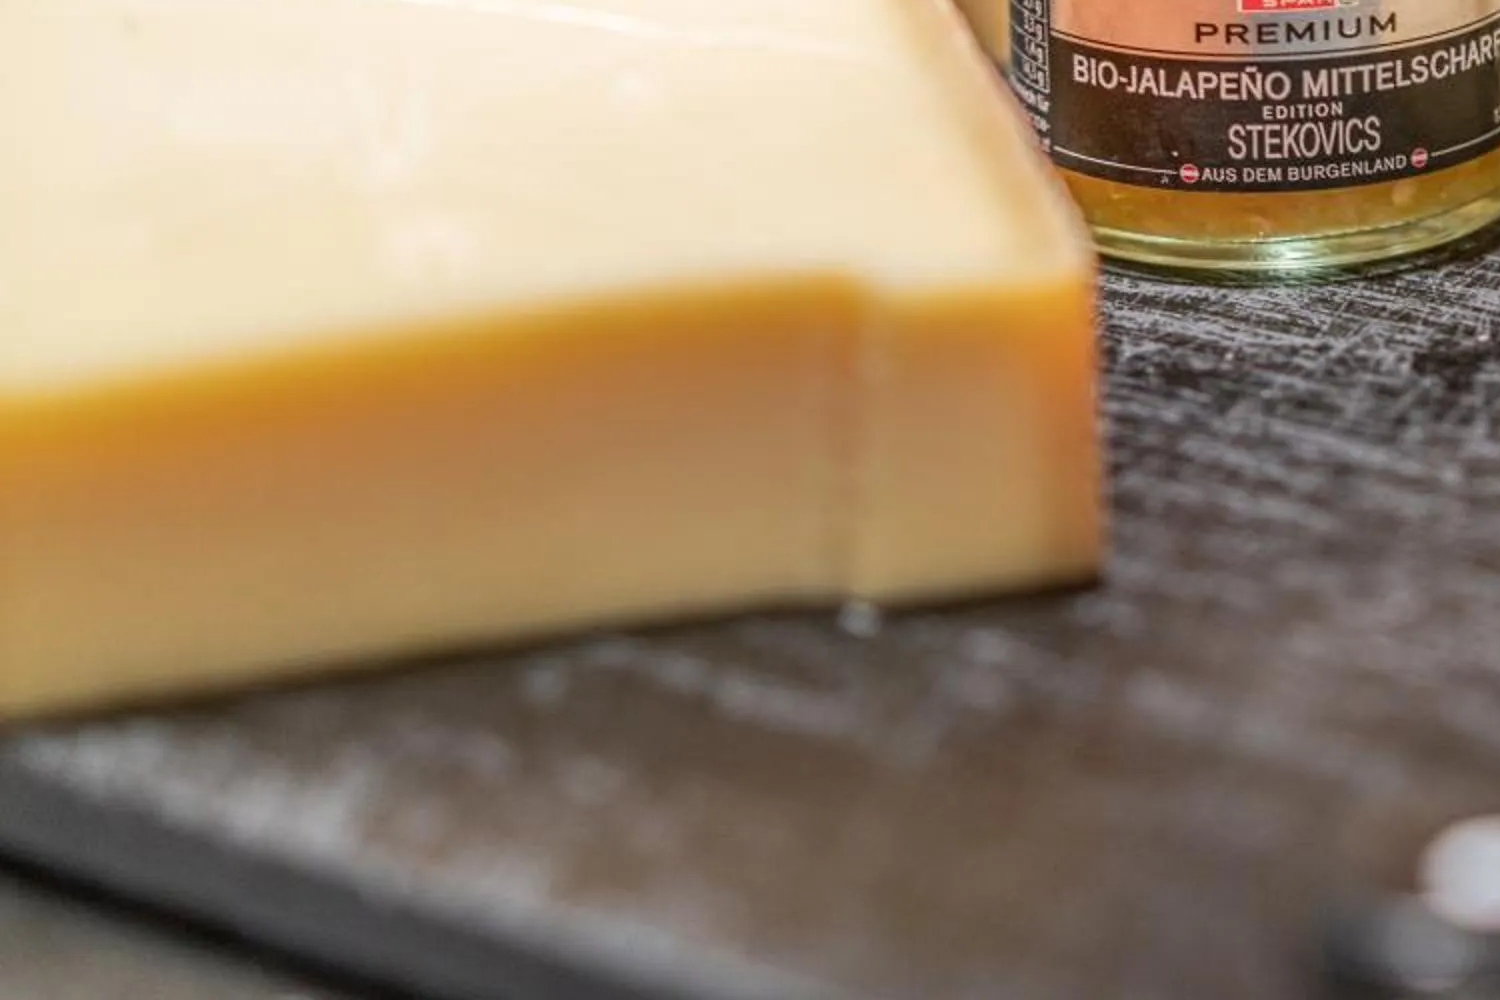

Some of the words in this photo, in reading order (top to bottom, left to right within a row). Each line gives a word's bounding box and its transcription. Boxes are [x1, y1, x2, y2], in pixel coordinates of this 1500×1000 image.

[1194, 12, 1397, 44] PREMIUM
[1071, 53, 1292, 101] BIO-JALAPEÑO
[1262, 102, 1343, 120] EDITION
[1227, 116, 1382, 160] STEKOVICS
[1201, 167, 1237, 183] AUS
[1243, 165, 1283, 183] DEM
[1287, 154, 1407, 181] BURGENLAND
